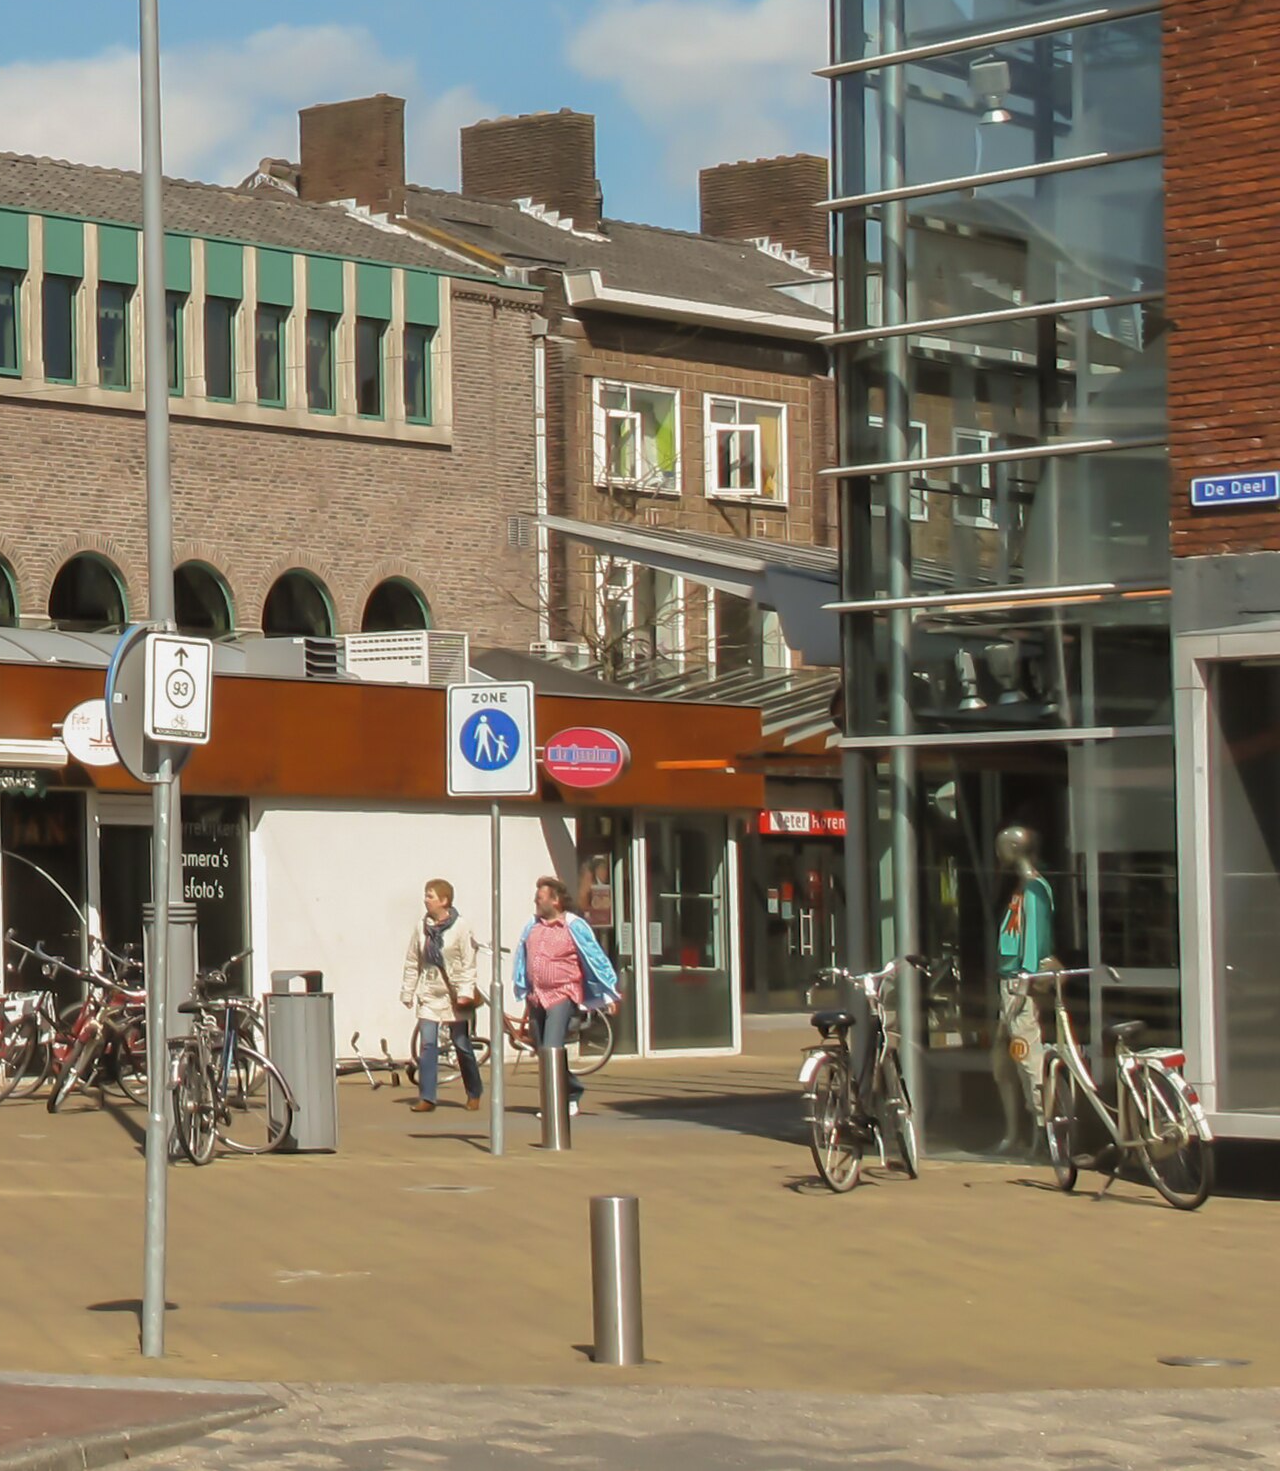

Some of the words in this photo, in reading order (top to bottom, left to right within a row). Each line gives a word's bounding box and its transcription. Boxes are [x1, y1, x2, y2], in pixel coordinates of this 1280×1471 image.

[1204, 483, 1225, 497] De
[1231, 478, 1266, 495] Deel
[173, 681, 189, 697] 93
[471, 692, 508, 704] ZONE
